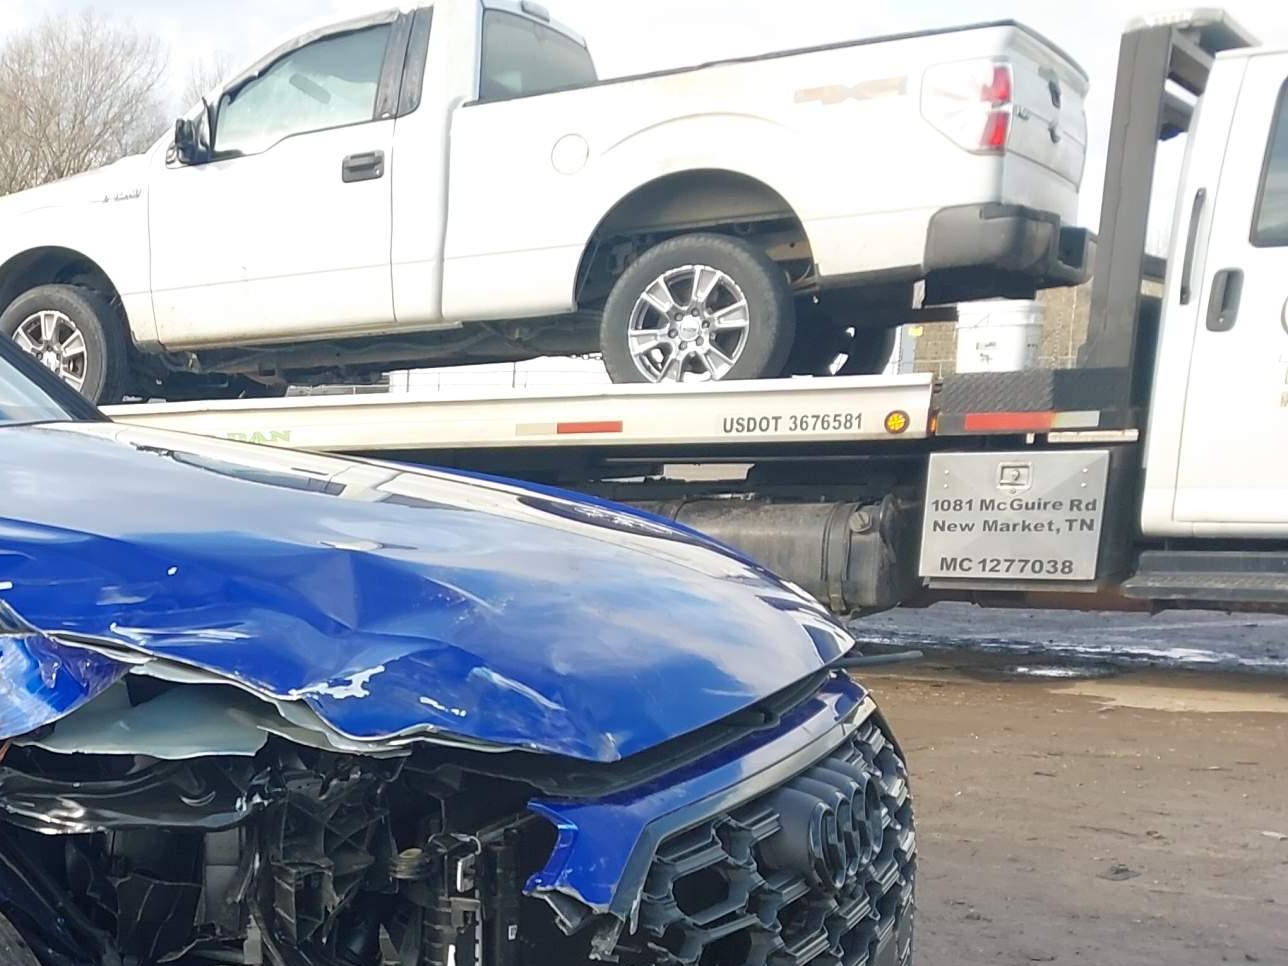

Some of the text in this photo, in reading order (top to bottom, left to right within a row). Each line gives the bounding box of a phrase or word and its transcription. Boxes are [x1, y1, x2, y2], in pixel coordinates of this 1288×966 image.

[723, 413, 863, 433] USDOT 3676581
[932, 498, 1097, 512] 1081 McGuire Rd
[932, 518, 1095, 535] New Market, TN
[939, 557, 1074, 575] MC 1277038
